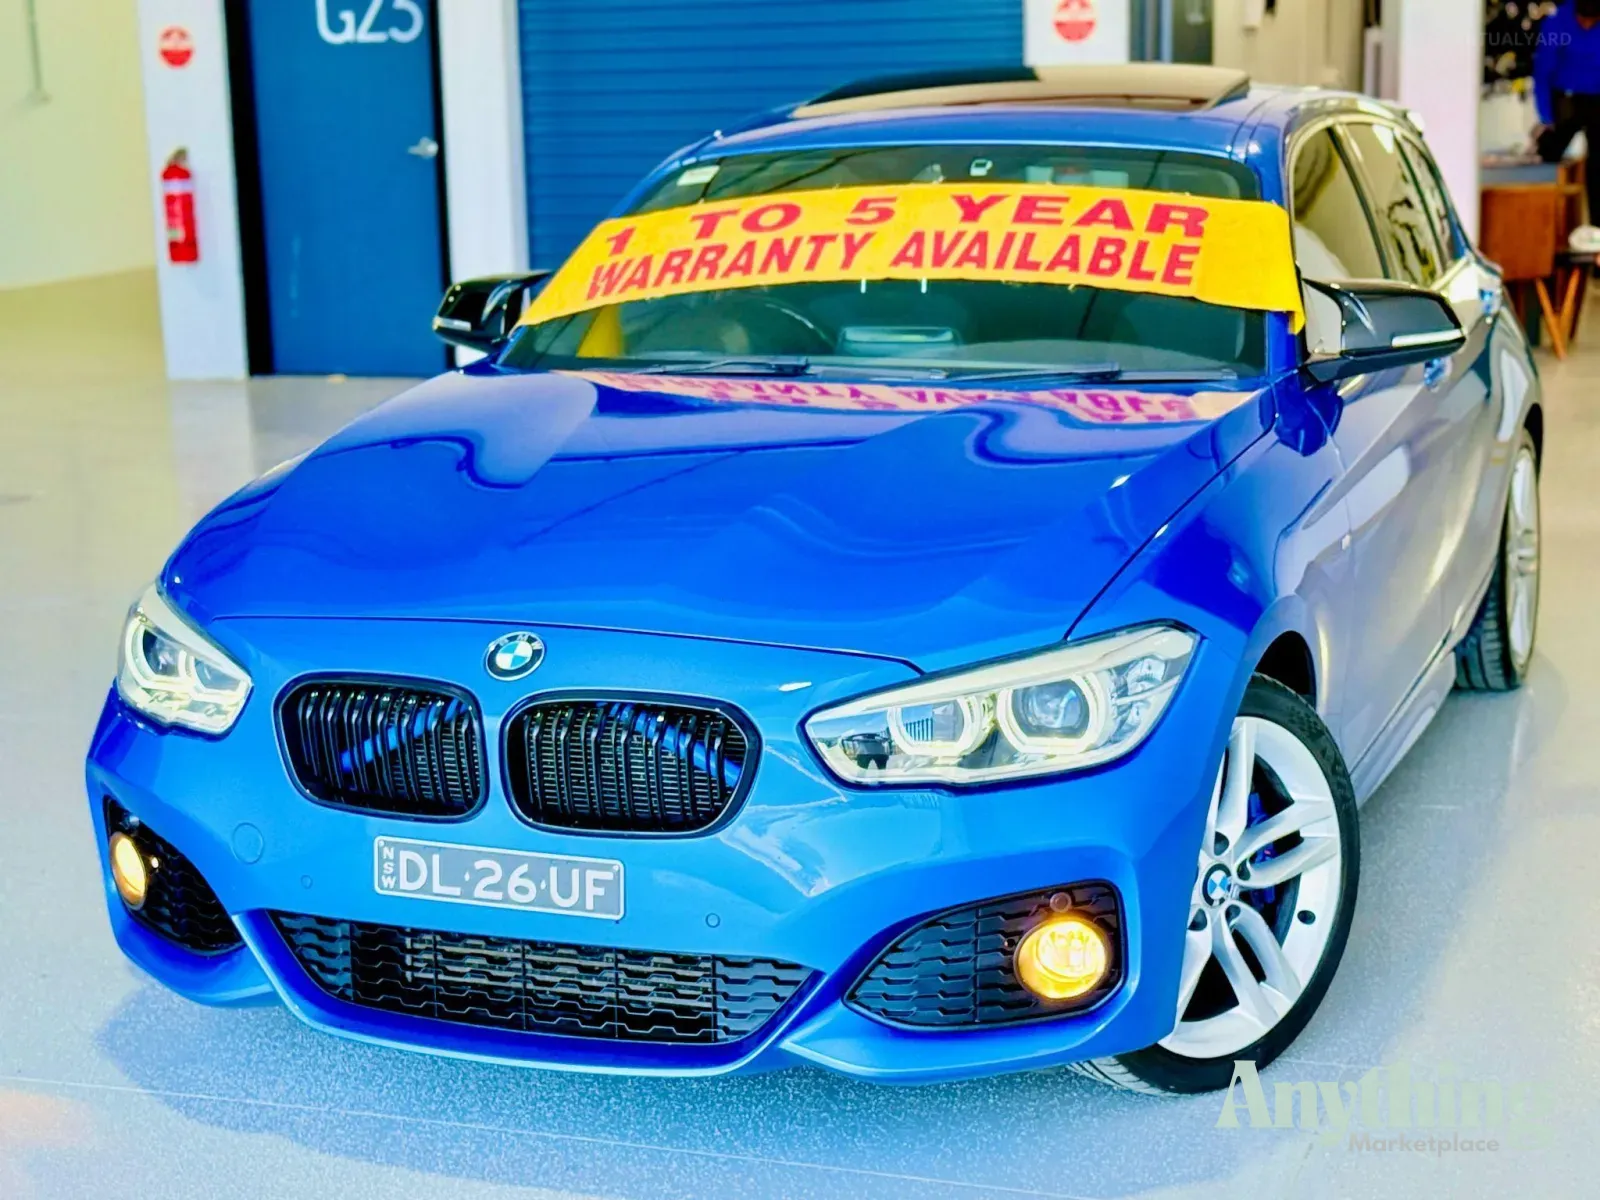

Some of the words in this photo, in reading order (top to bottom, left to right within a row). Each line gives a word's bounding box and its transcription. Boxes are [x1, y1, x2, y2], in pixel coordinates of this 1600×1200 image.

[606, 227, 637, 256] 1
[690, 203, 802, 241] TO
[846, 197, 897, 225] 5
[951, 195, 1210, 239] YEAR
[586, 232, 876, 301] WARRANTY
[889, 230, 1201, 286] AVAILABLE
[382, 846, 396, 889] NSW
[400, 850, 462, 897] DL
[474, 859, 537, 904] 26
[550, 865, 615, 911] UF
